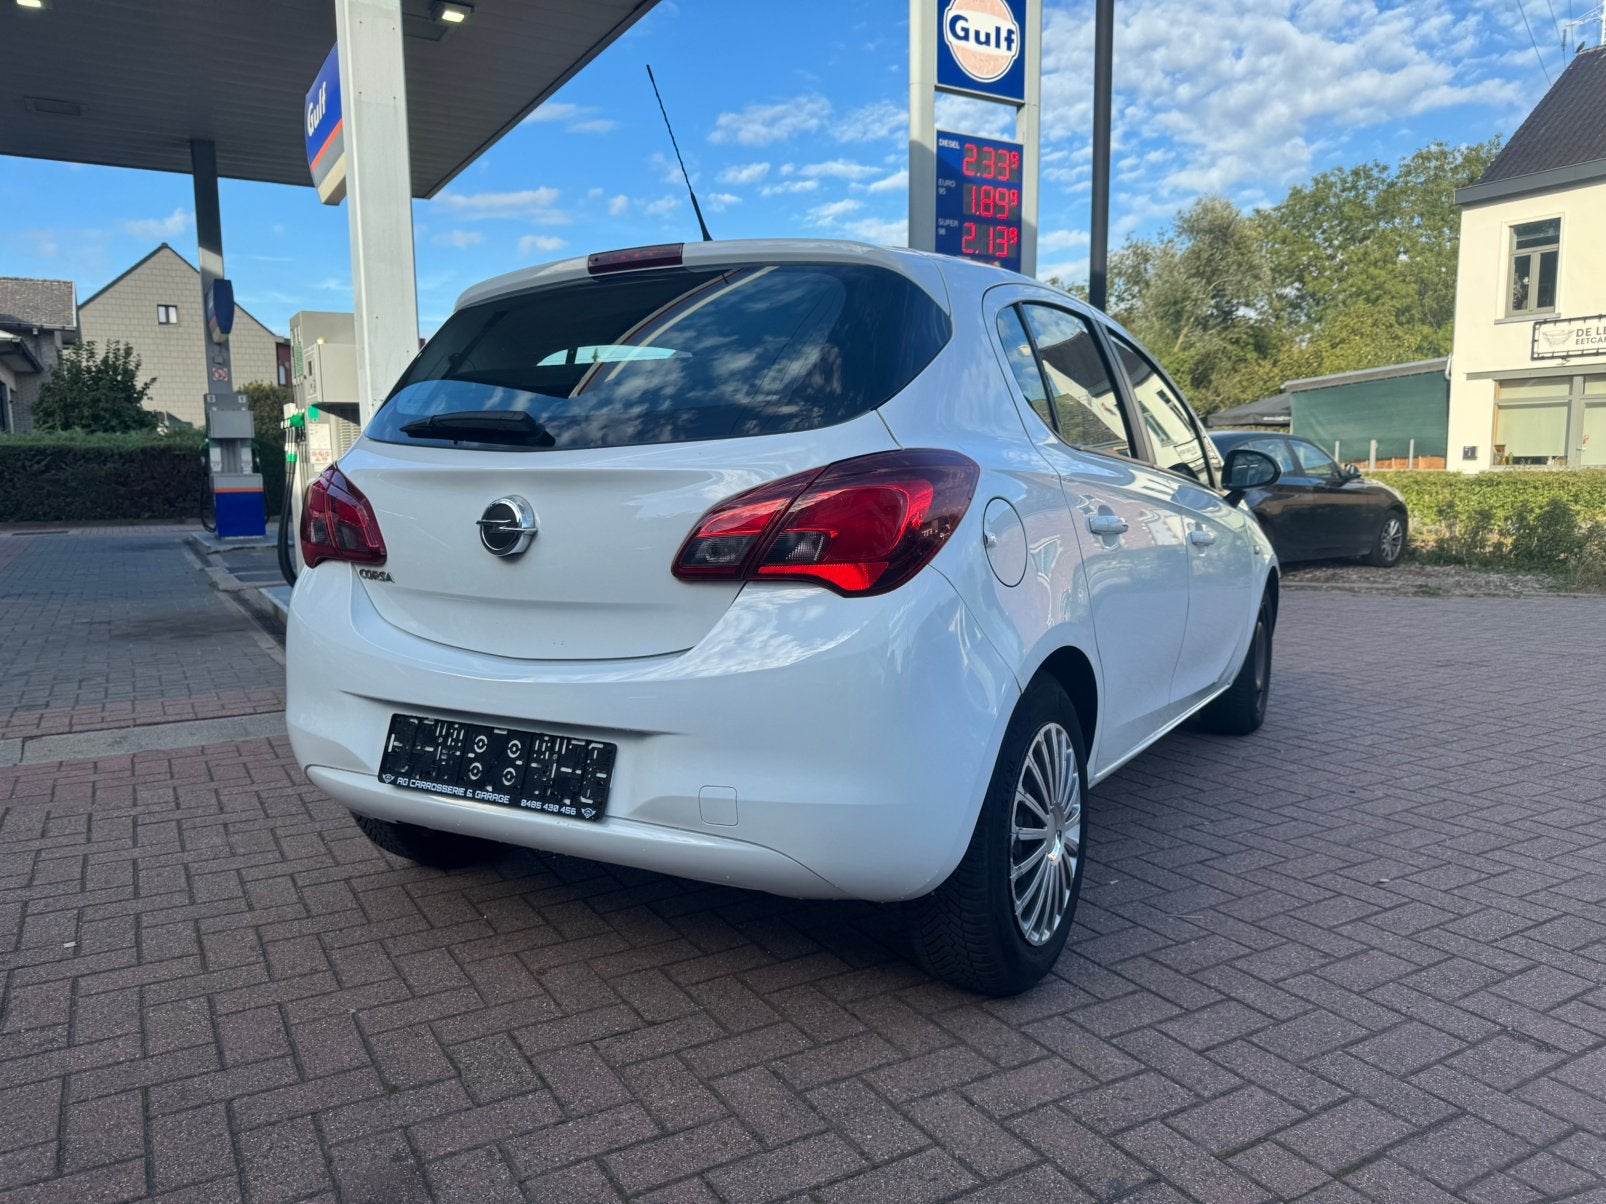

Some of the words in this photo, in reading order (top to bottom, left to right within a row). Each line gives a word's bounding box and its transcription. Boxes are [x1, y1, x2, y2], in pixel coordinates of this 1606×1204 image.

[949, 14, 1015, 52] Gulf
[306, 81, 327, 136] Gulf
[938, 138, 960, 150] DIESEL
[938, 178, 956, 187] EURO
[937, 218, 959, 227] SUPER
[1576, 328, 1592, 337] DE
[359, 568, 395, 583] CORSA
[409, 779, 465, 796] CARROSSERIE
[466, 789, 473, 798] &
[474, 790, 510, 804] GARAGE
